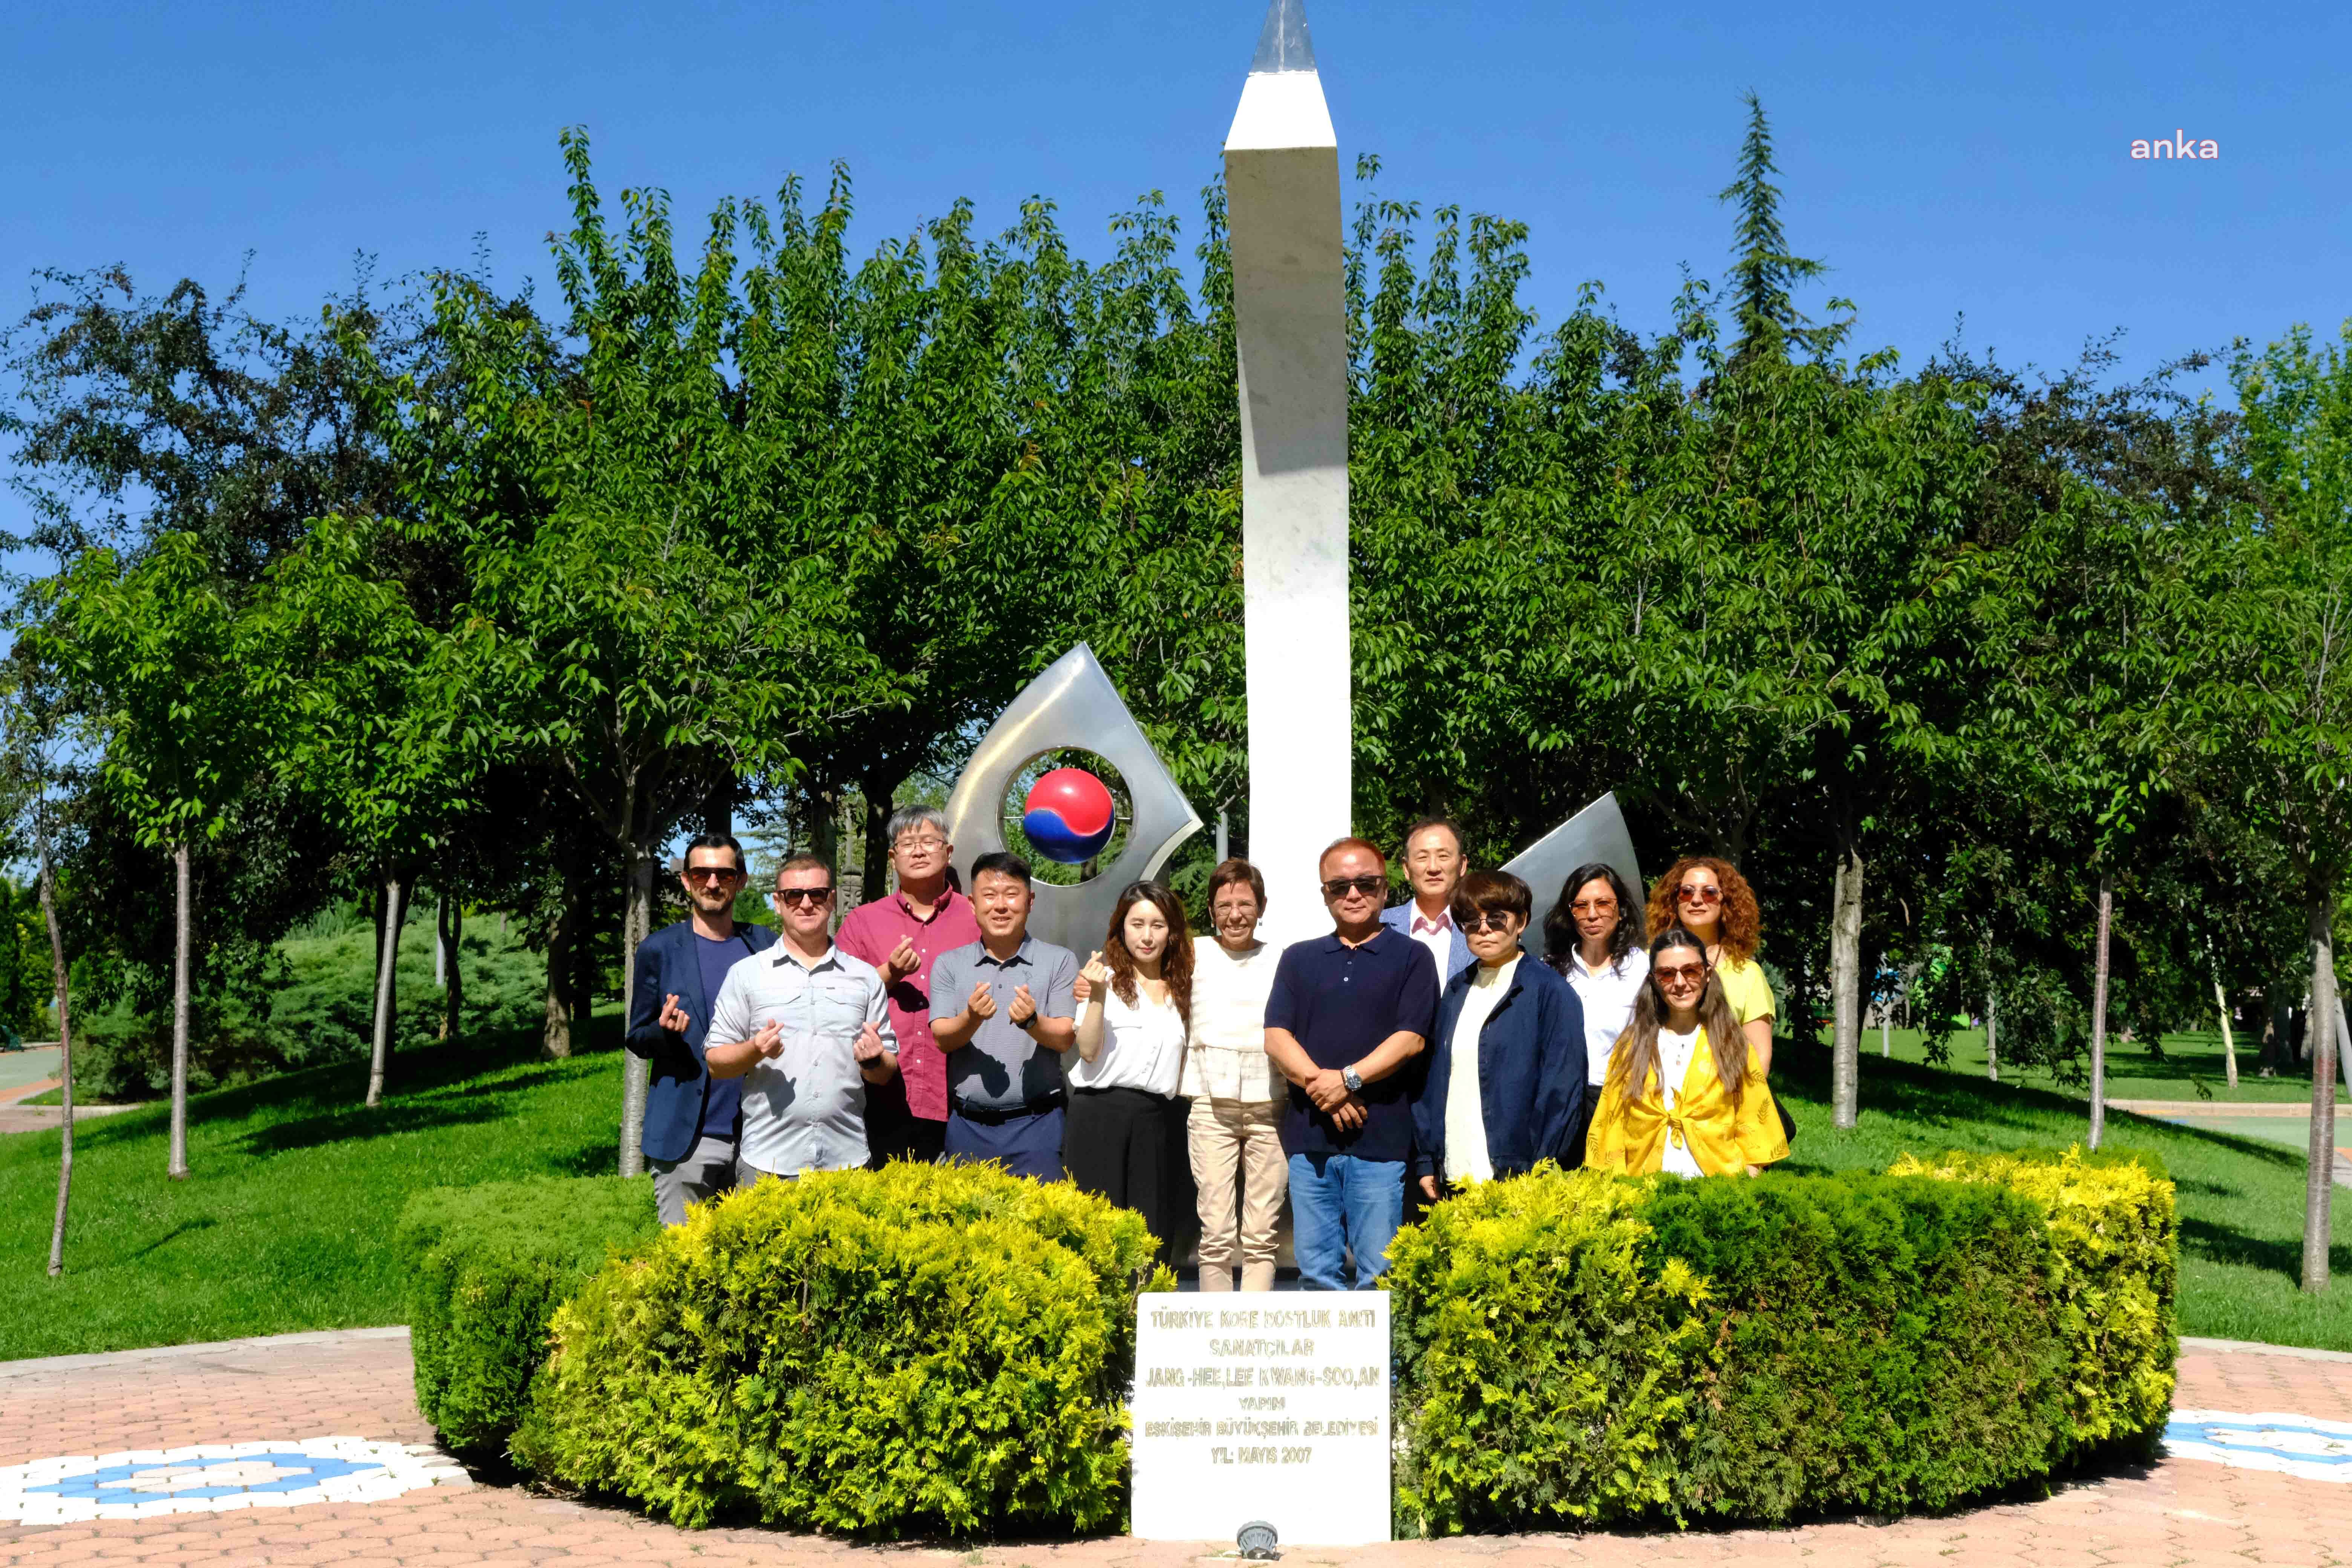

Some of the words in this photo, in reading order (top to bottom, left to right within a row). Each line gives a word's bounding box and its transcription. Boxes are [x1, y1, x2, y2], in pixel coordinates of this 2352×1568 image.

[1150, 1306, 1213, 1329] TÜRKİYE
[1220, 1309, 1259, 1328] KORE
[1264, 1309, 1331, 1328] DOSTLUK
[1209, 1338, 1315, 1360] SANATÇILAR
[1238, 1396, 1285, 1411] YAPIM
[1145, 1417, 1212, 1439] ESKİŞEHİR
[1216, 1416, 1298, 1439] BÜYÜKŞEHİR
[1303, 1416, 1378, 1436] BELEDİYESİ
[1238, 1447, 1277, 1464] MAYIS
[1281, 1447, 1312, 1464] 2007
